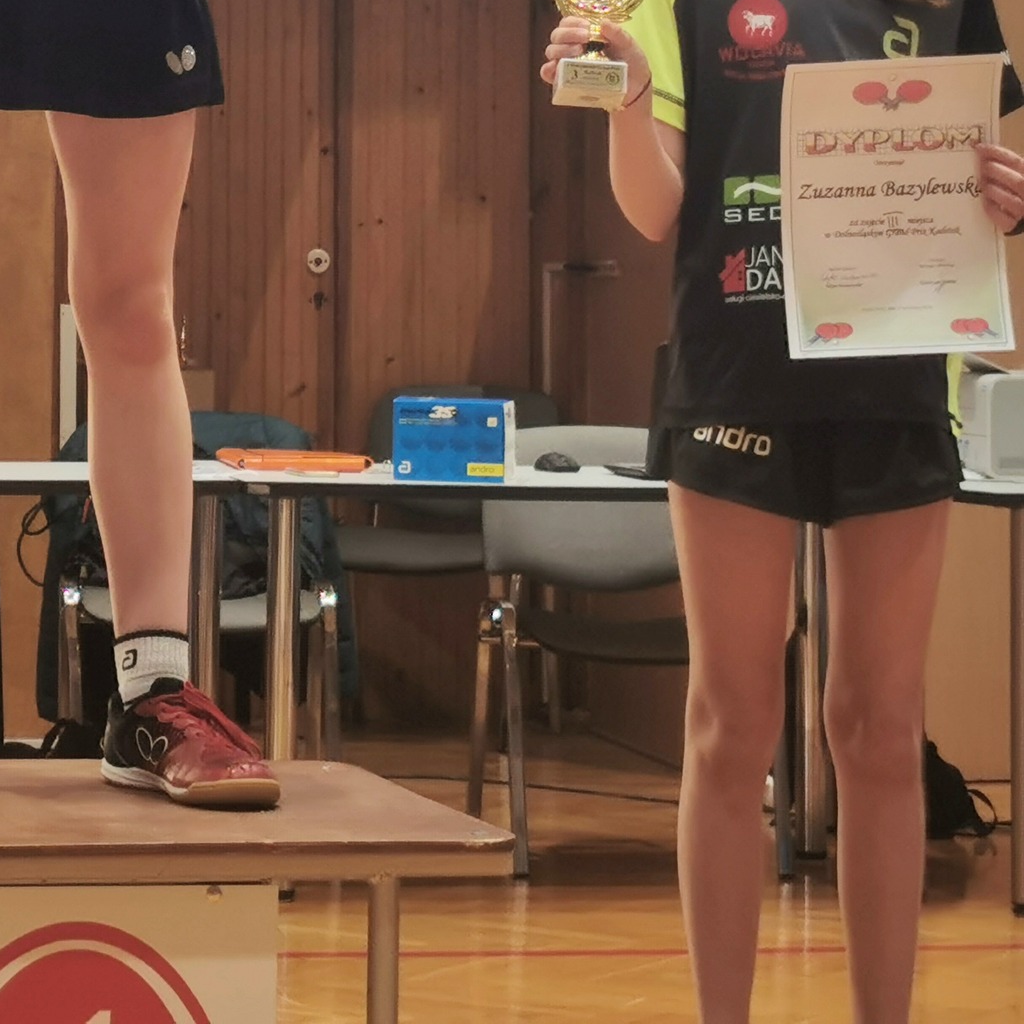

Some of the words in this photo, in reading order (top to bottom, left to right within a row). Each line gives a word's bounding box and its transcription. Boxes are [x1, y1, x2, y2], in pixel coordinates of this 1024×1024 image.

[805, 125, 983, 156] DYPLOM
[797, 183, 877, 201] Zuzanna
[693, 425, 771, 456] andro
